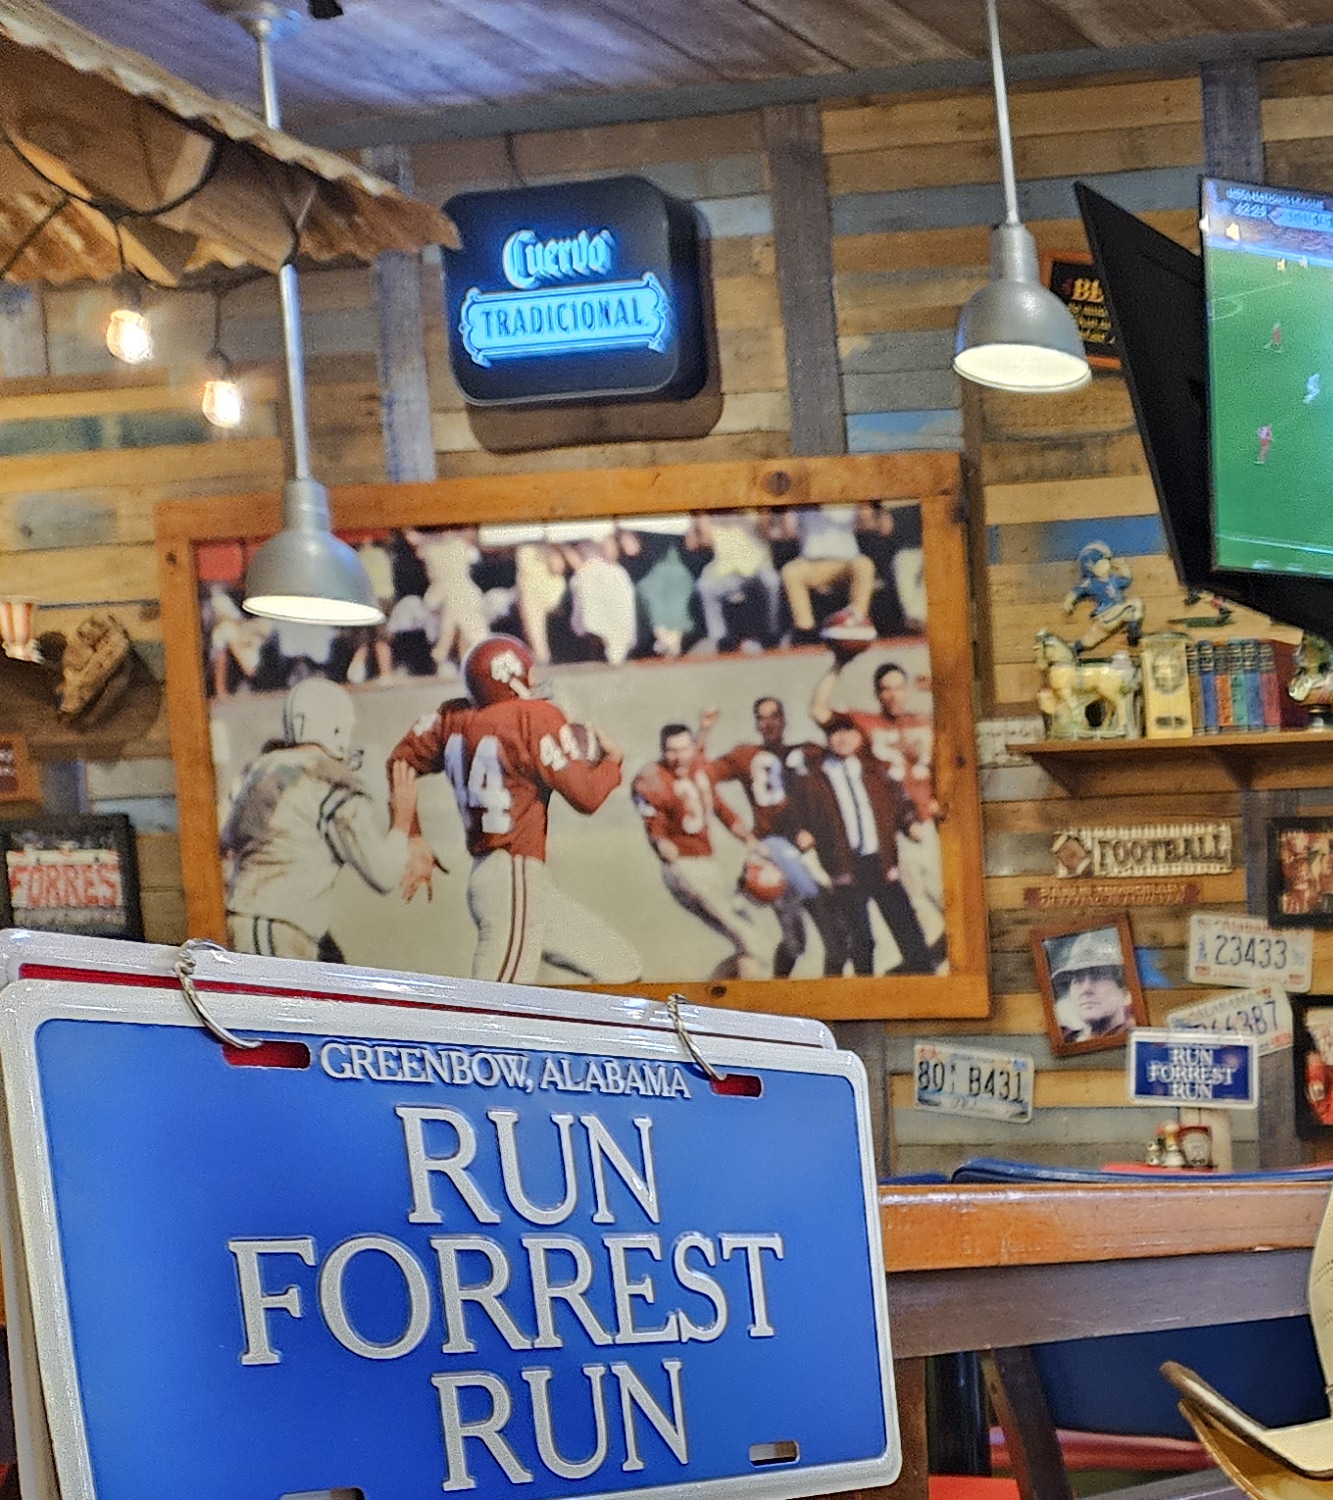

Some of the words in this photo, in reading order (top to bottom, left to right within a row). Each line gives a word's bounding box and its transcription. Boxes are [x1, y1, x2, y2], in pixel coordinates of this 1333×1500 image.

[502, 229, 616, 289] Cuervo
[481, 297, 644, 340] TRADICIONAL
[1214, 934, 1288, 970] 23433
[319, 1040, 534, 1093] GREENBOW,
[540, 1056, 692, 1100] ALABAMA
[1146, 1061, 1238, 1085] FORREST
[1171, 1047, 1214, 1066] RUN
[1171, 1082, 1214, 1100] RUN
[394, 1104, 660, 1226] RUN
[228, 1232, 786, 1368] FORREST
[430, 1358, 692, 1494] RUN
